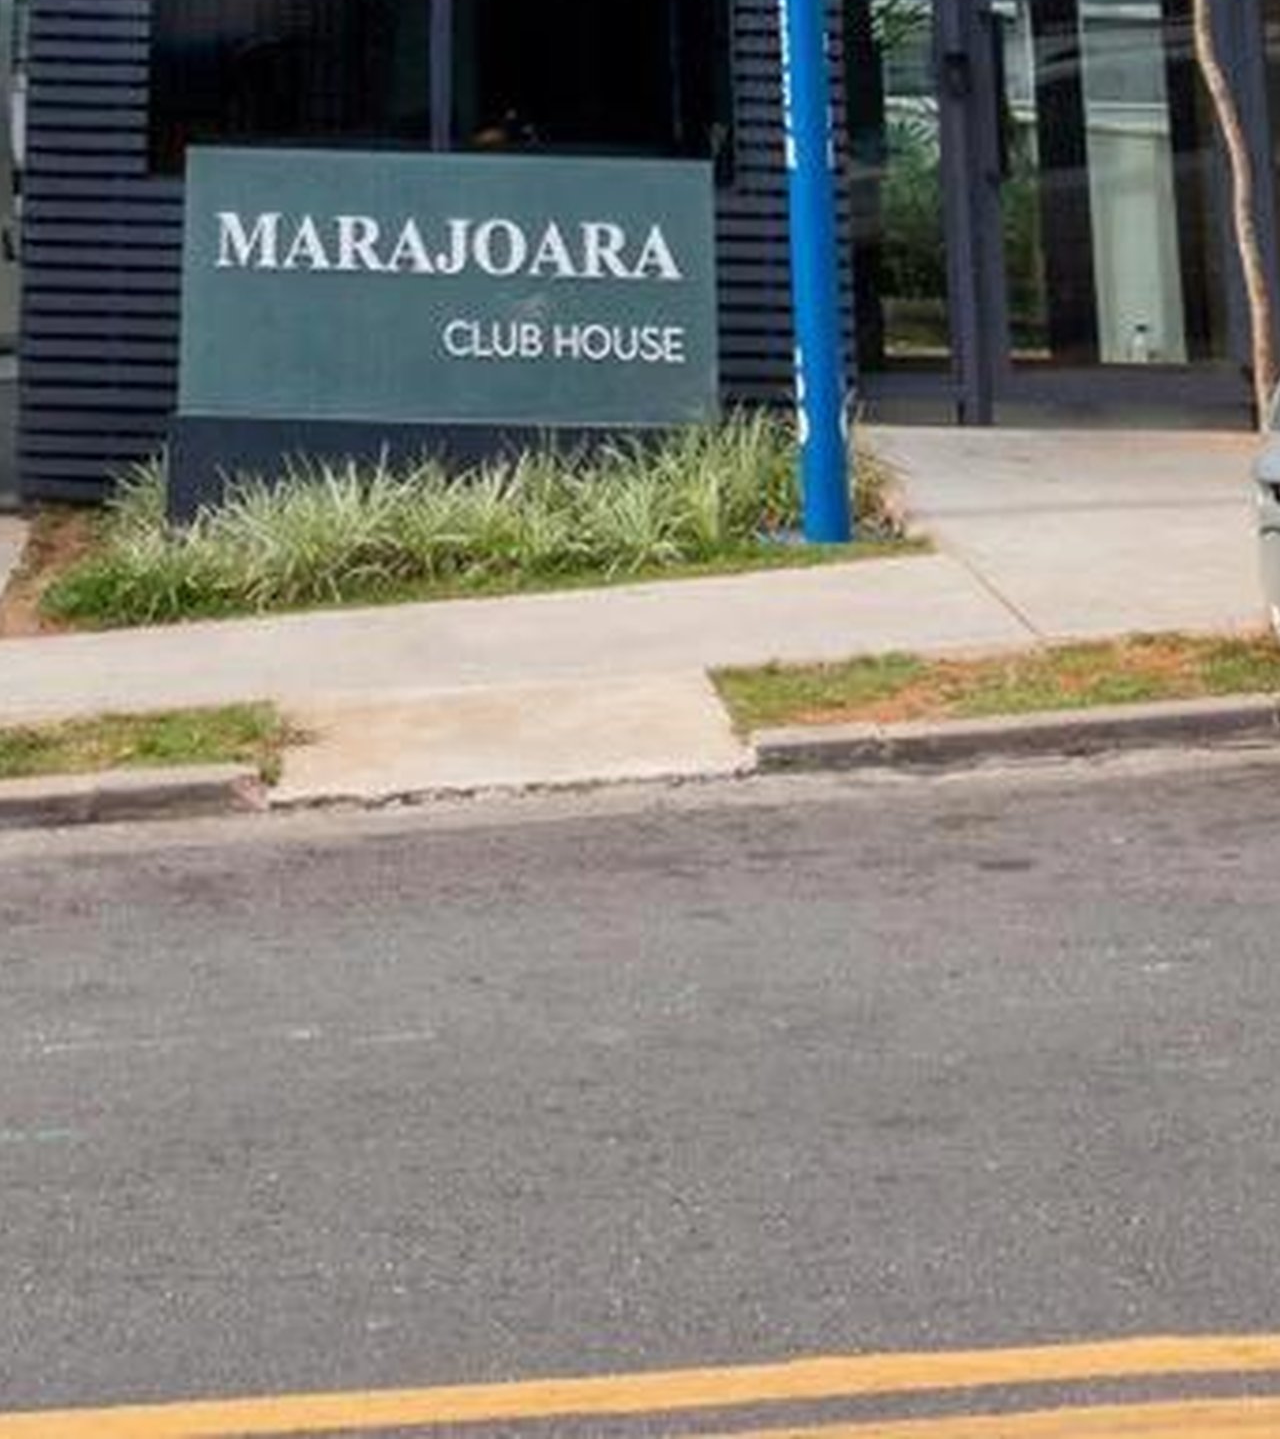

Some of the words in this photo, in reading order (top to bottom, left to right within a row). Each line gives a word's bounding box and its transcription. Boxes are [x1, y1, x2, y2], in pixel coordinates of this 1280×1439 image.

[214, 211, 683, 280] MARAJOARA
[442, 319, 545, 358] CLUB
[553, 323, 686, 363] HOUSE
